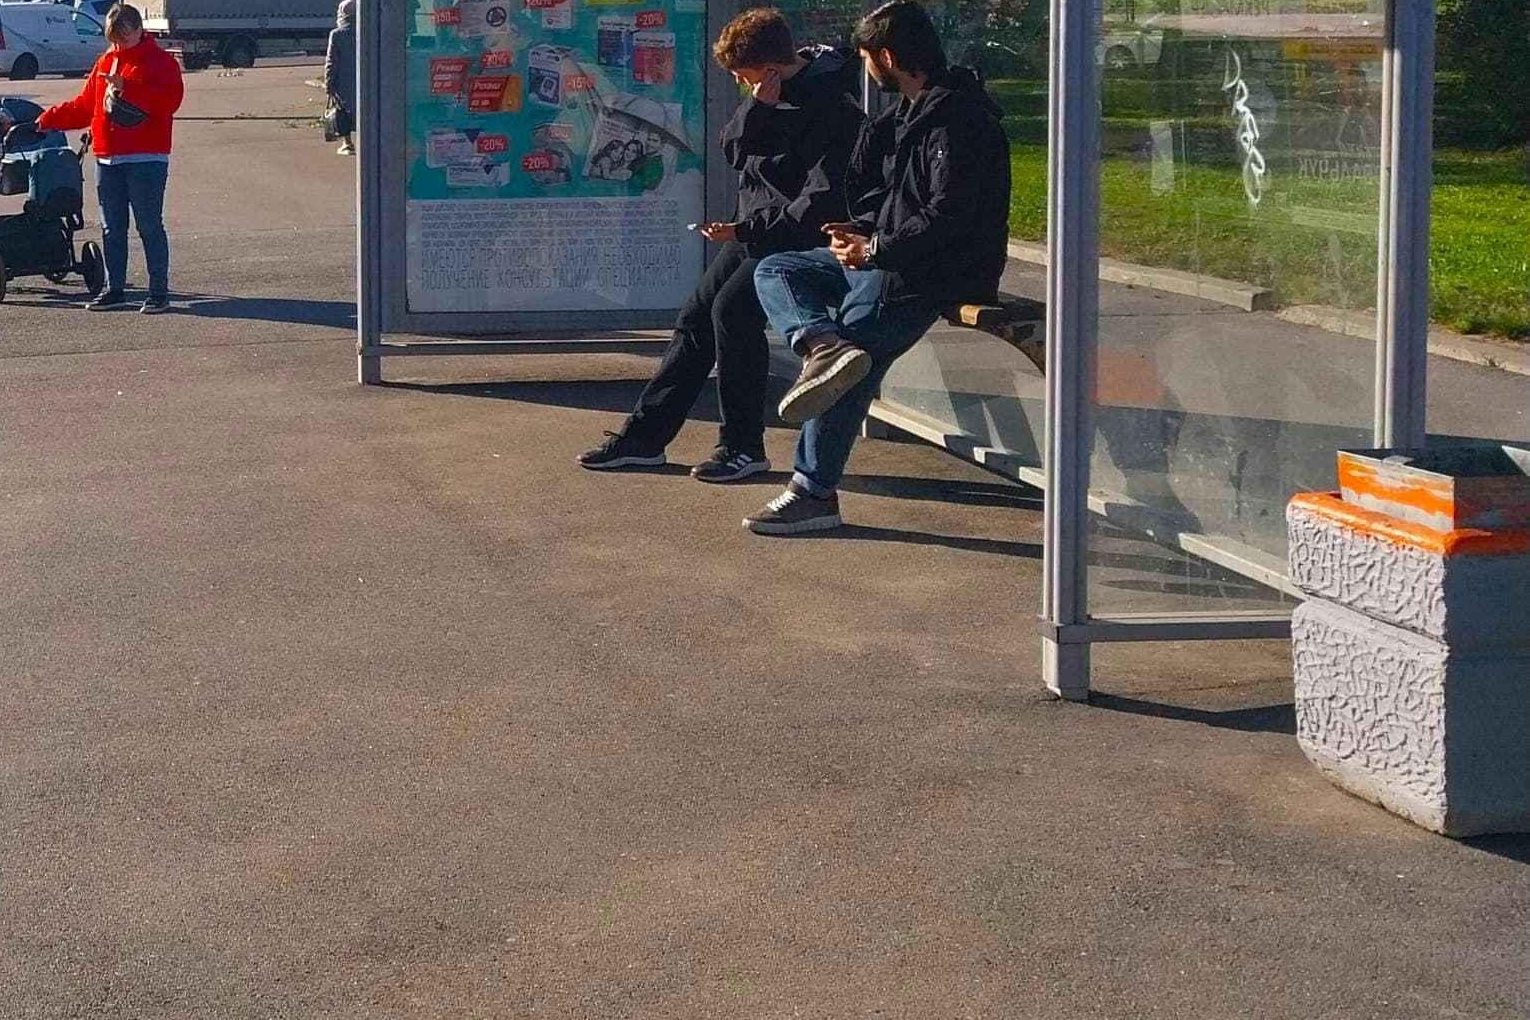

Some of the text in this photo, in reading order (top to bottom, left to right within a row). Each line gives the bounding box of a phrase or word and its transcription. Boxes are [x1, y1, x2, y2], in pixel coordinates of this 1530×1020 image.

[638, 13, 664, 26] -20%
[567, 76, 593, 89] -15%
[479, 138, 505, 151] -20%
[523, 155, 550, 170] -20%
[422, 249, 478, 268] ИМЕЮТСЯ
[604, 247, 681, 267] НЕОБХОДИМО
[422, 268, 680, 290] ПОЛУЧЕНИЕ КОНСУЛЬТАЦИИ СПЕЦИАЛИСТА
